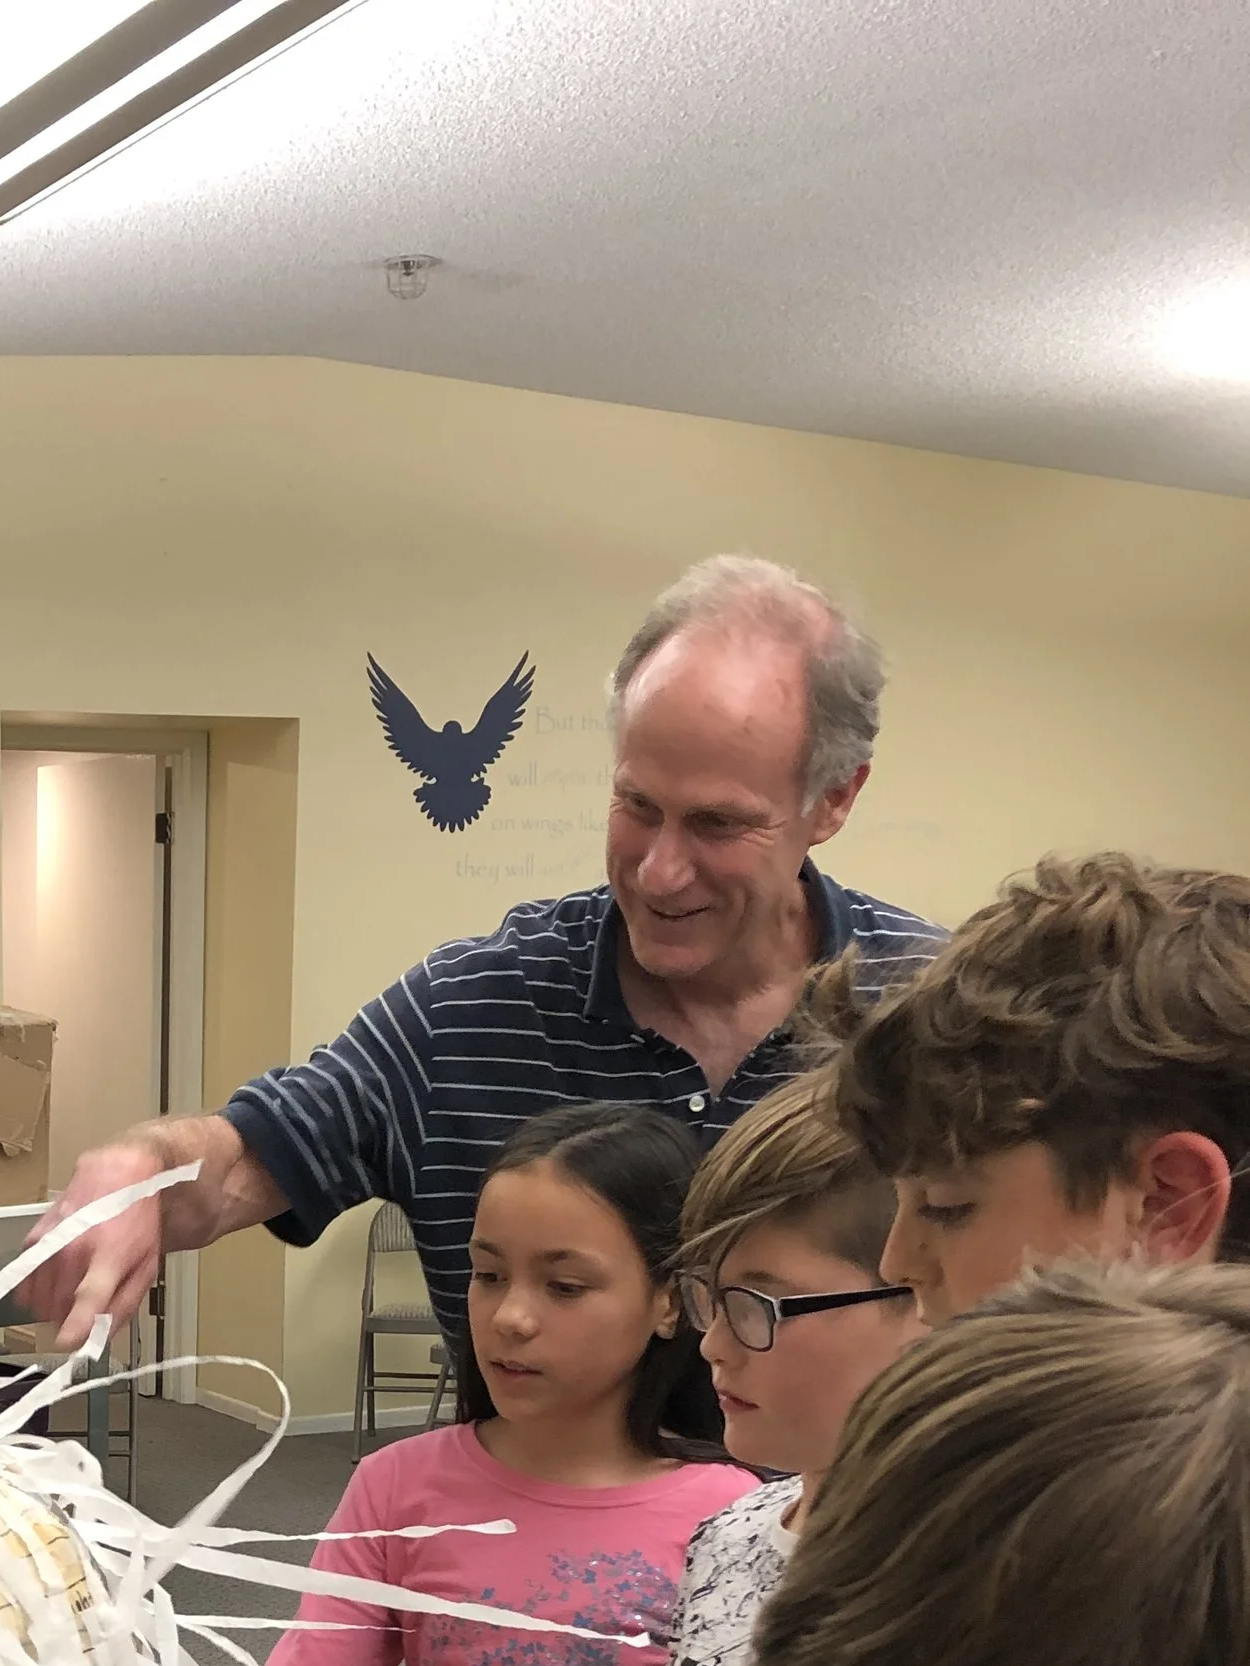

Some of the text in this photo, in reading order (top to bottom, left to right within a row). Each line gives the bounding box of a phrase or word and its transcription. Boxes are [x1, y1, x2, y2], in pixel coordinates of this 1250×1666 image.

[535, 707, 574, 735] But
[508, 761, 538, 787] will
[521, 815, 574, 839] wings
[456, 852, 500, 885] they
[505, 852, 534, 878] will
